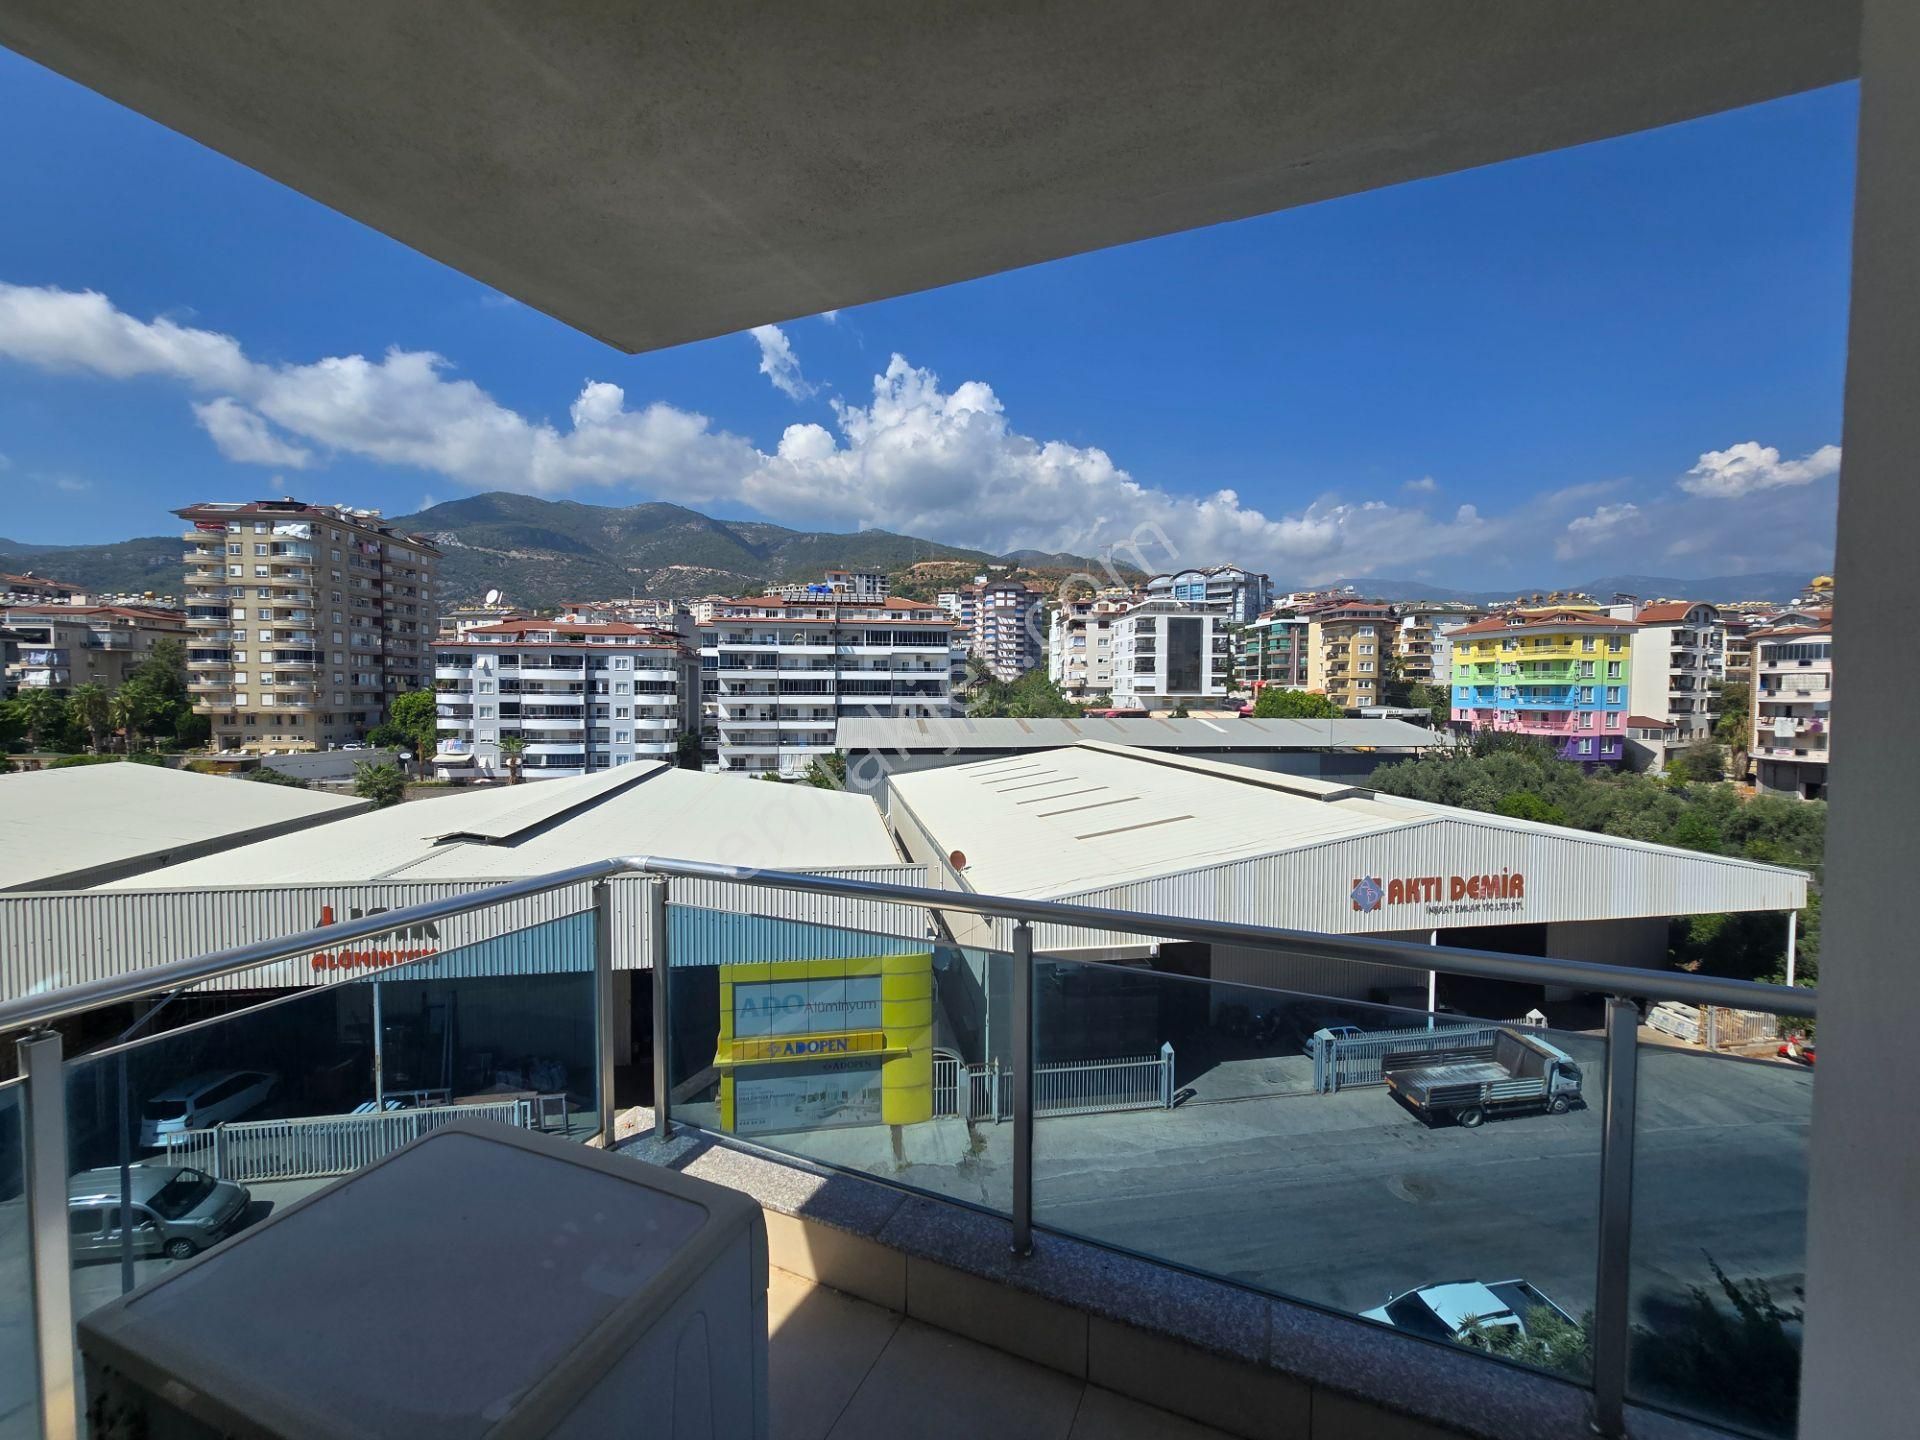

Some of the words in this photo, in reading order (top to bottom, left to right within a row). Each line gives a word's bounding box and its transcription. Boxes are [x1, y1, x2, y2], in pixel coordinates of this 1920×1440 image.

[1388, 877, 1443, 905] AKTI
[1450, 866, 1525, 902] DEMİR
[739, 994, 804, 1019] ADO
[804, 1000, 877, 1015] Alüminyum
[783, 1038, 848, 1056] ADOPEN
